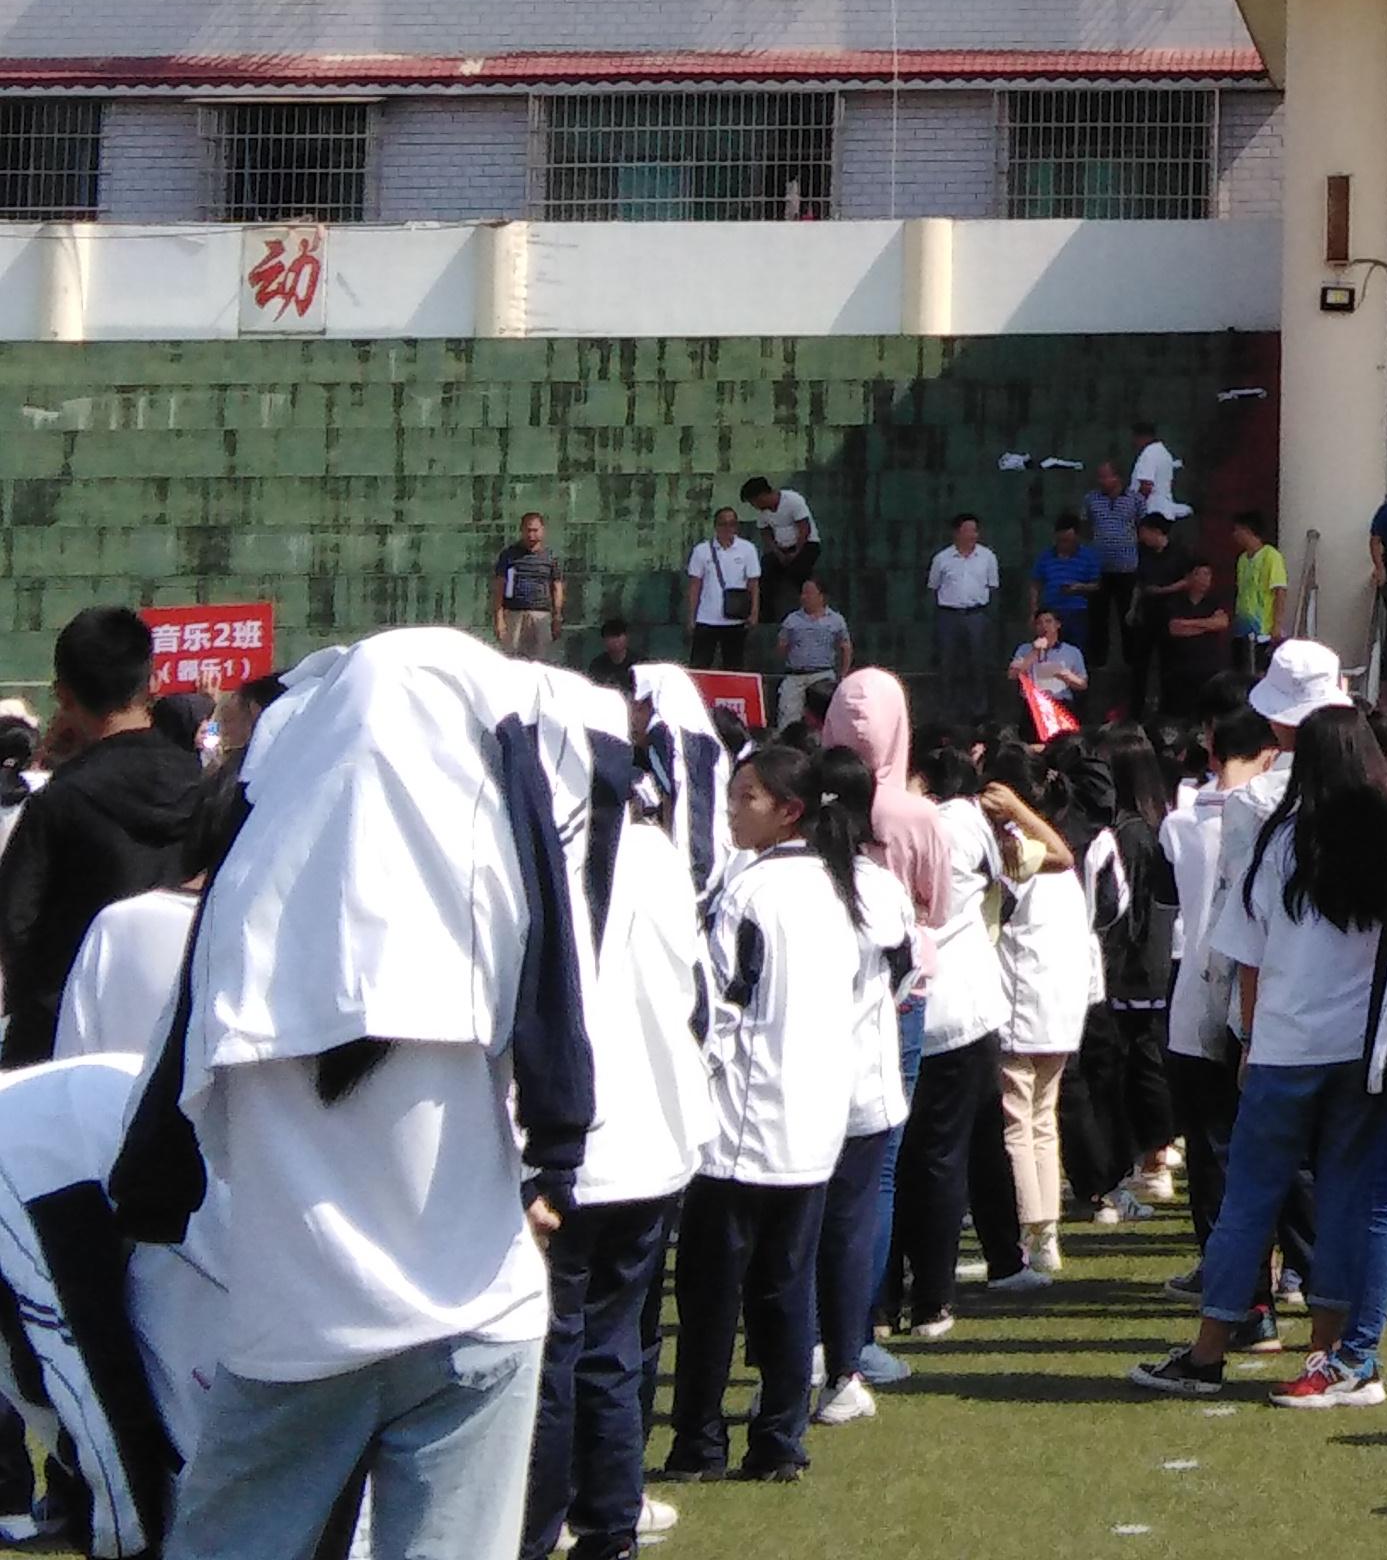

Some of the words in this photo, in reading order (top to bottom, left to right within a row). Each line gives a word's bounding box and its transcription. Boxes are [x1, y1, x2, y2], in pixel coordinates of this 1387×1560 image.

[248, 238, 321, 322] 动
[151, 620, 262, 654] 音乐2班
